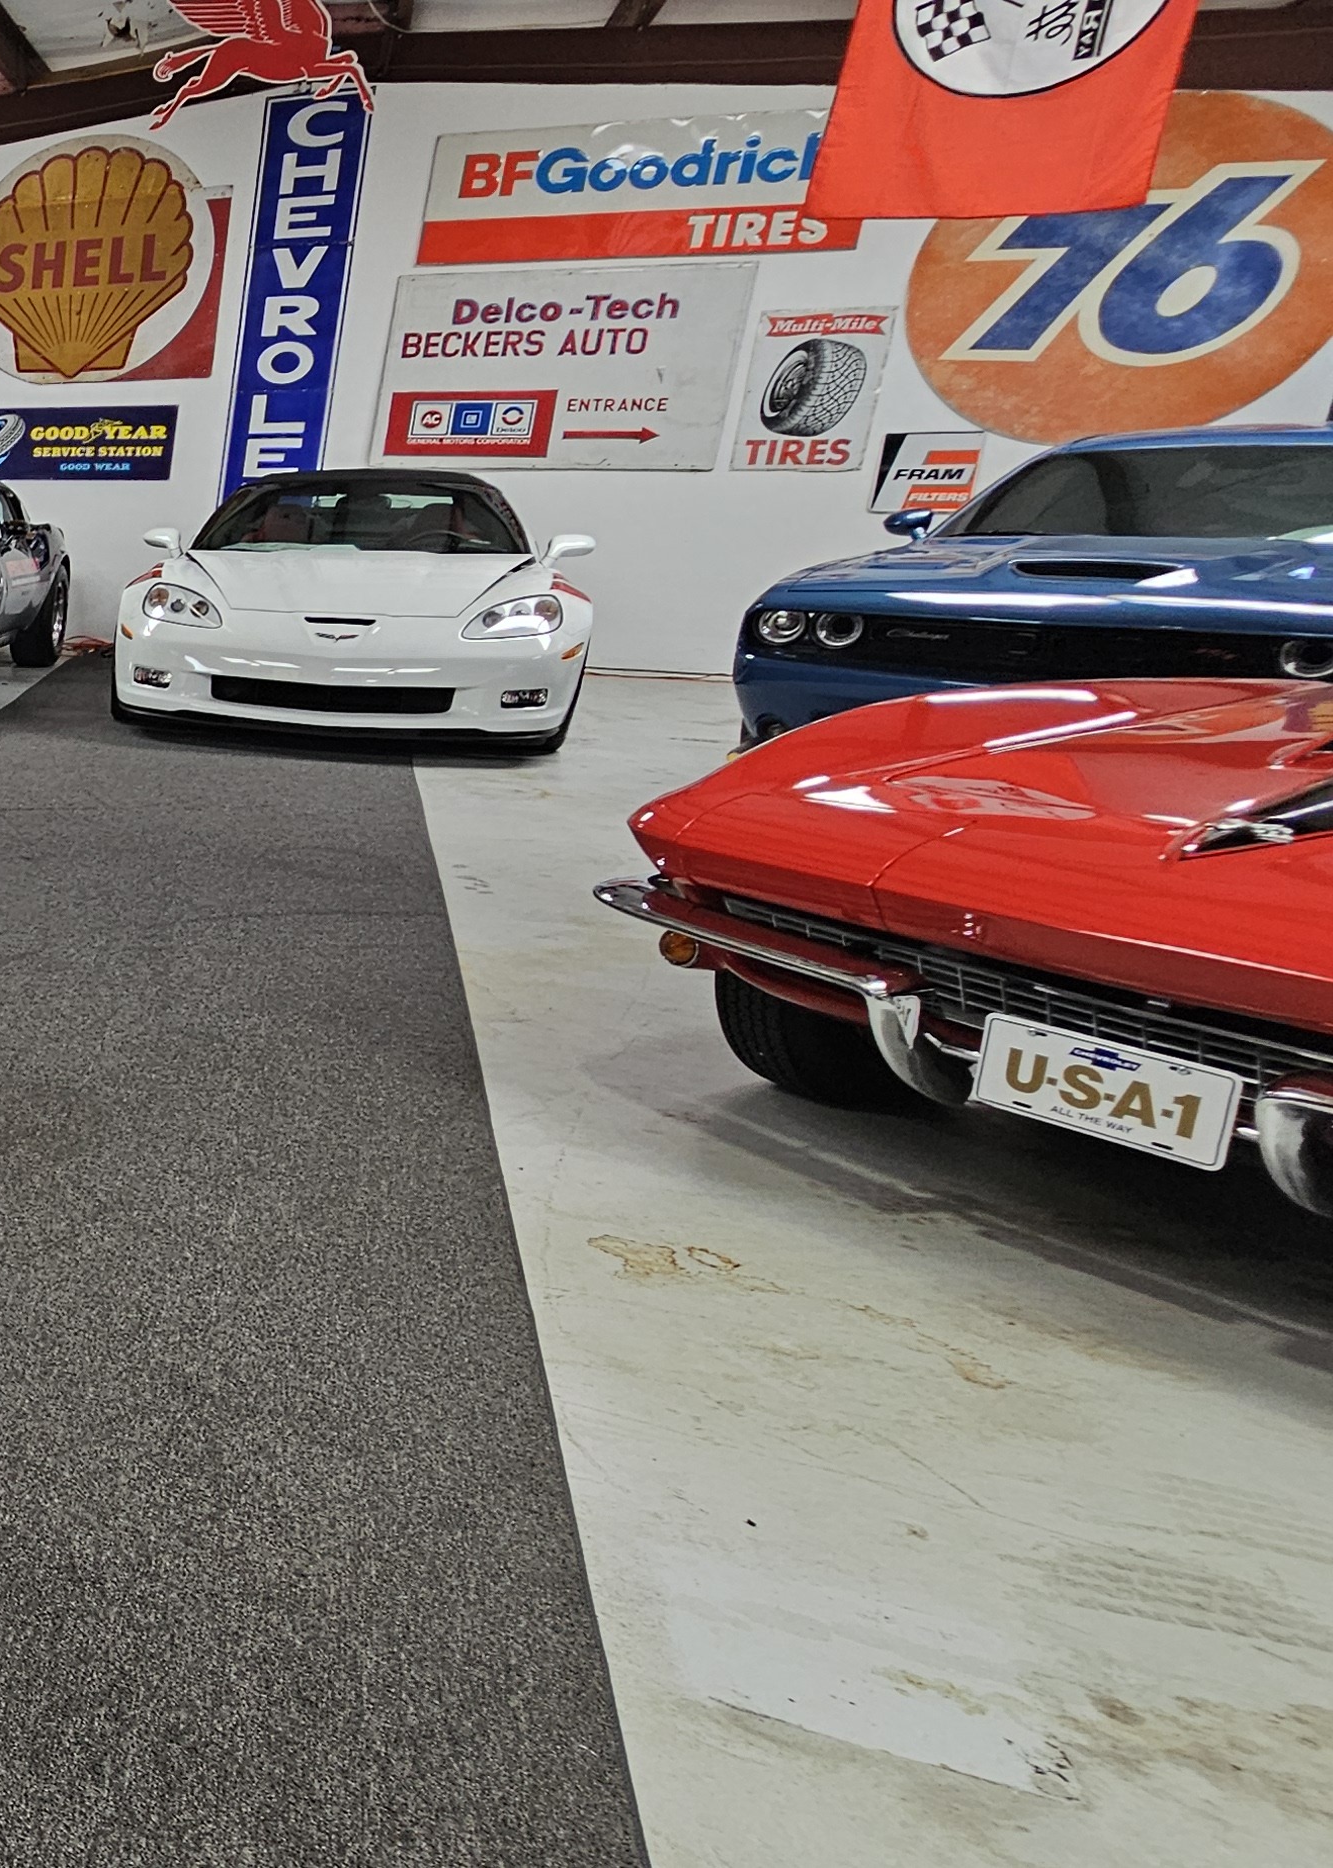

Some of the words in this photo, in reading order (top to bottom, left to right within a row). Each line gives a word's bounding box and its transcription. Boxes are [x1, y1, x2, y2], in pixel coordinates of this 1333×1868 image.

[687, 211, 829, 250] TIRES
[939, 160, 1326, 367] 76
[243, 102, 348, 478] CHEVROLE
[452, 293, 680, 325] Delco-Tech
[772, 317, 877, 333] Multi-Mile
[401, 329, 546, 358] BECKERS
[557, 328, 648, 356] AUTO
[567, 398, 669, 412] ENTRANCE
[421, 414, 441, 425] AC
[407, 437, 441, 445] GENERAL
[442, 437, 475, 445] MOTORS
[476, 437, 531, 446] CORPORATION
[33, 446, 95, 458] SERVICE
[97, 445, 164, 457] STATION
[745, 438, 852, 466] TIRES
[59, 462, 91, 471] GOOD
[94, 462, 131, 471] WEAR
[893, 468, 966, 481] FRAM
[908, 491, 970, 502] FILTERS
[1073, 1049, 1139, 1070] CHEVROLET
[1050, 1105, 1074, 1119] ALL
[1077, 1112, 1102, 1126] THE
[1106, 1120, 1134, 1134] WAY
